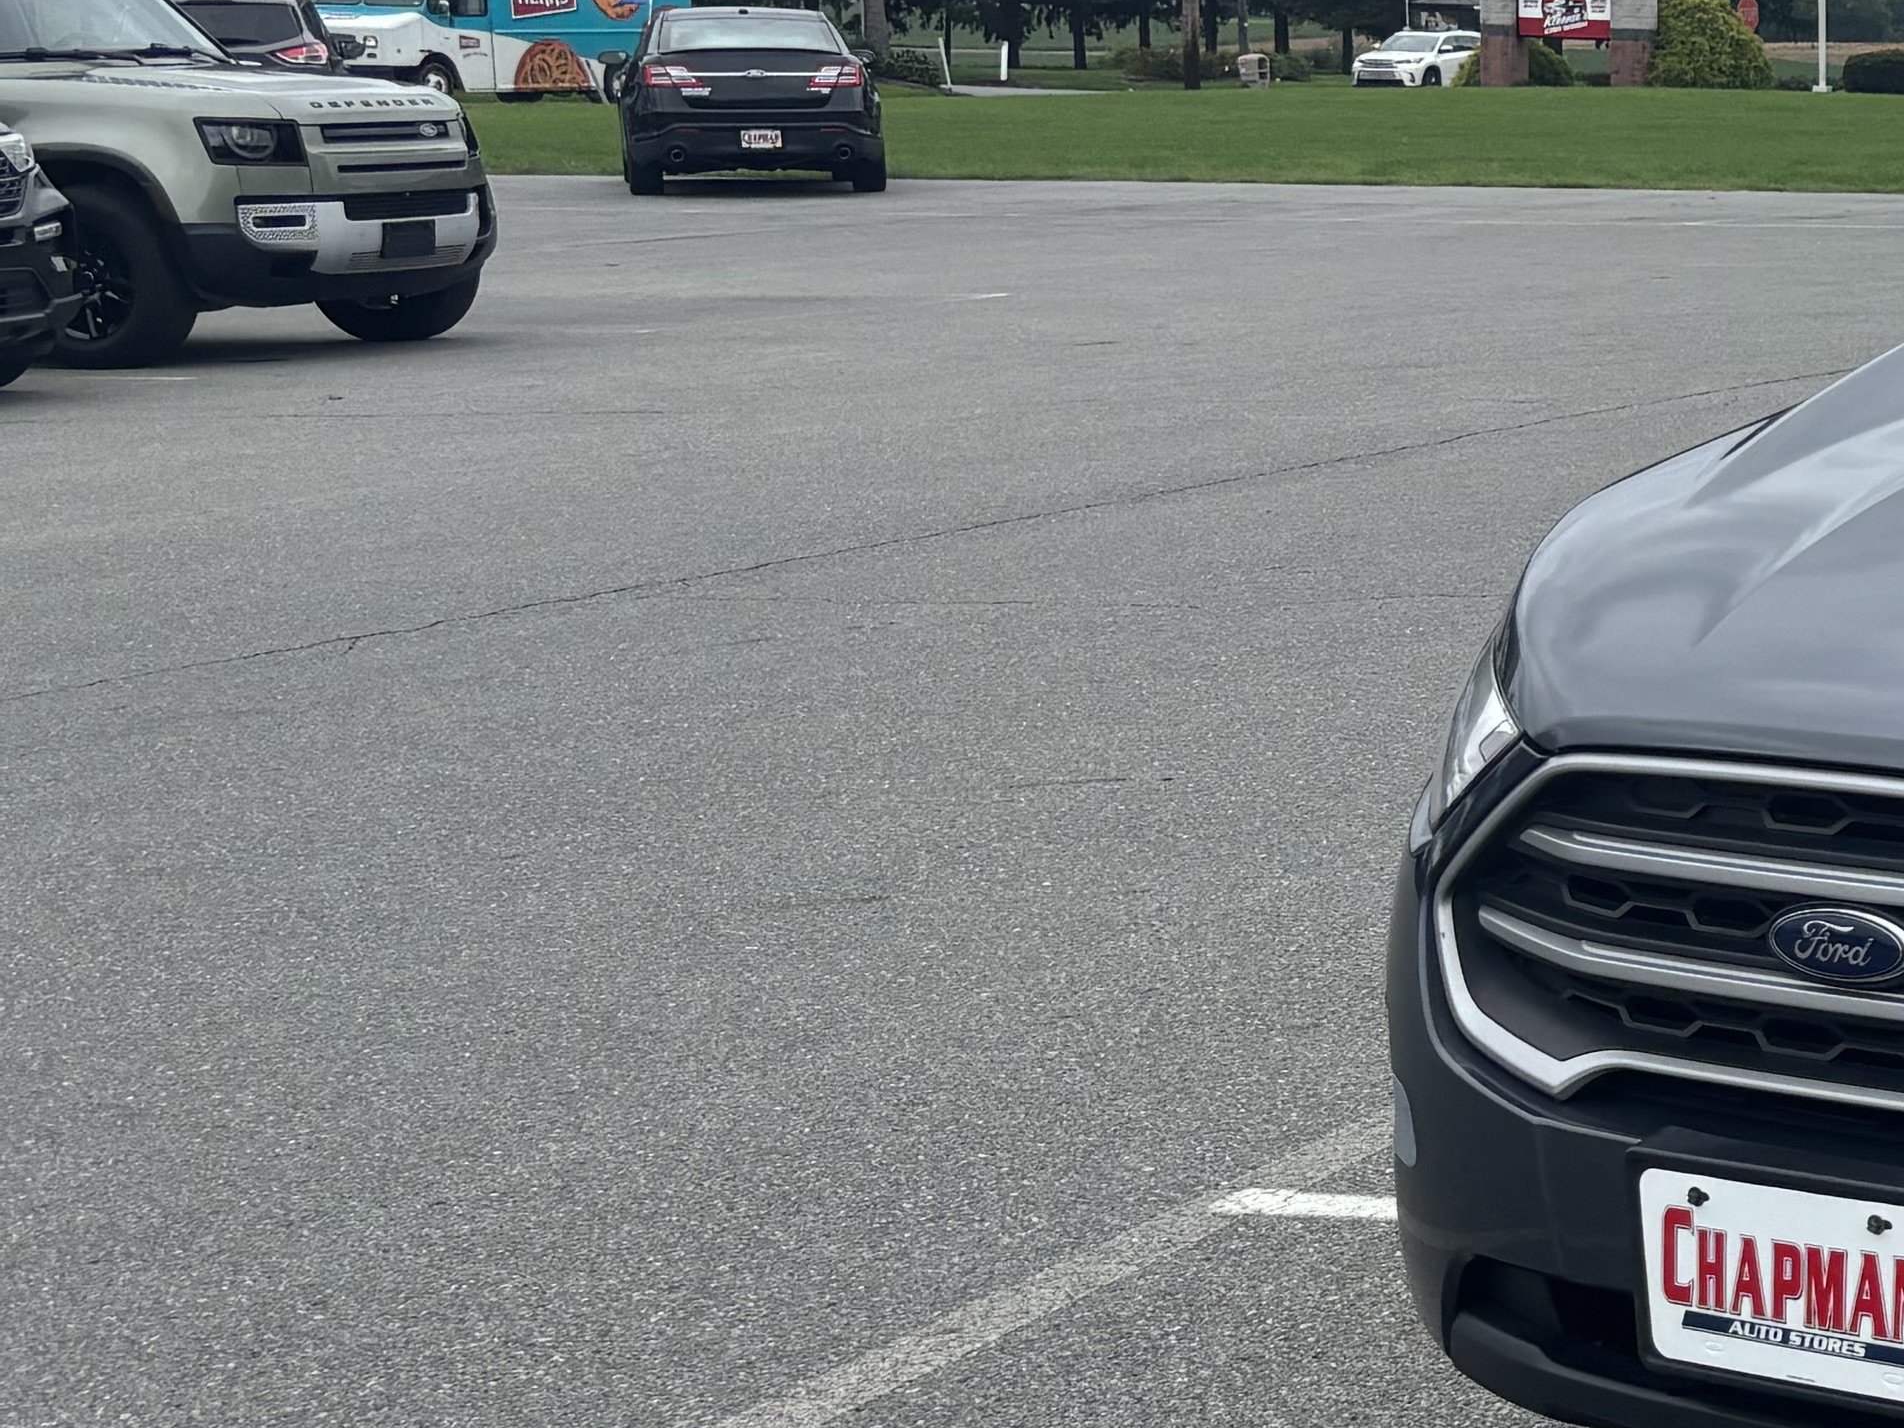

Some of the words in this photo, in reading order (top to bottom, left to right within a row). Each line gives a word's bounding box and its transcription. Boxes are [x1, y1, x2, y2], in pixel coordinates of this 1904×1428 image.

[309, 98, 435, 109] DEFENDER
[1794, 920, 1875, 966] Ford
[1728, 1321, 1782, 1343] AUTO
[1788, 1332, 1866, 1357] STORES
